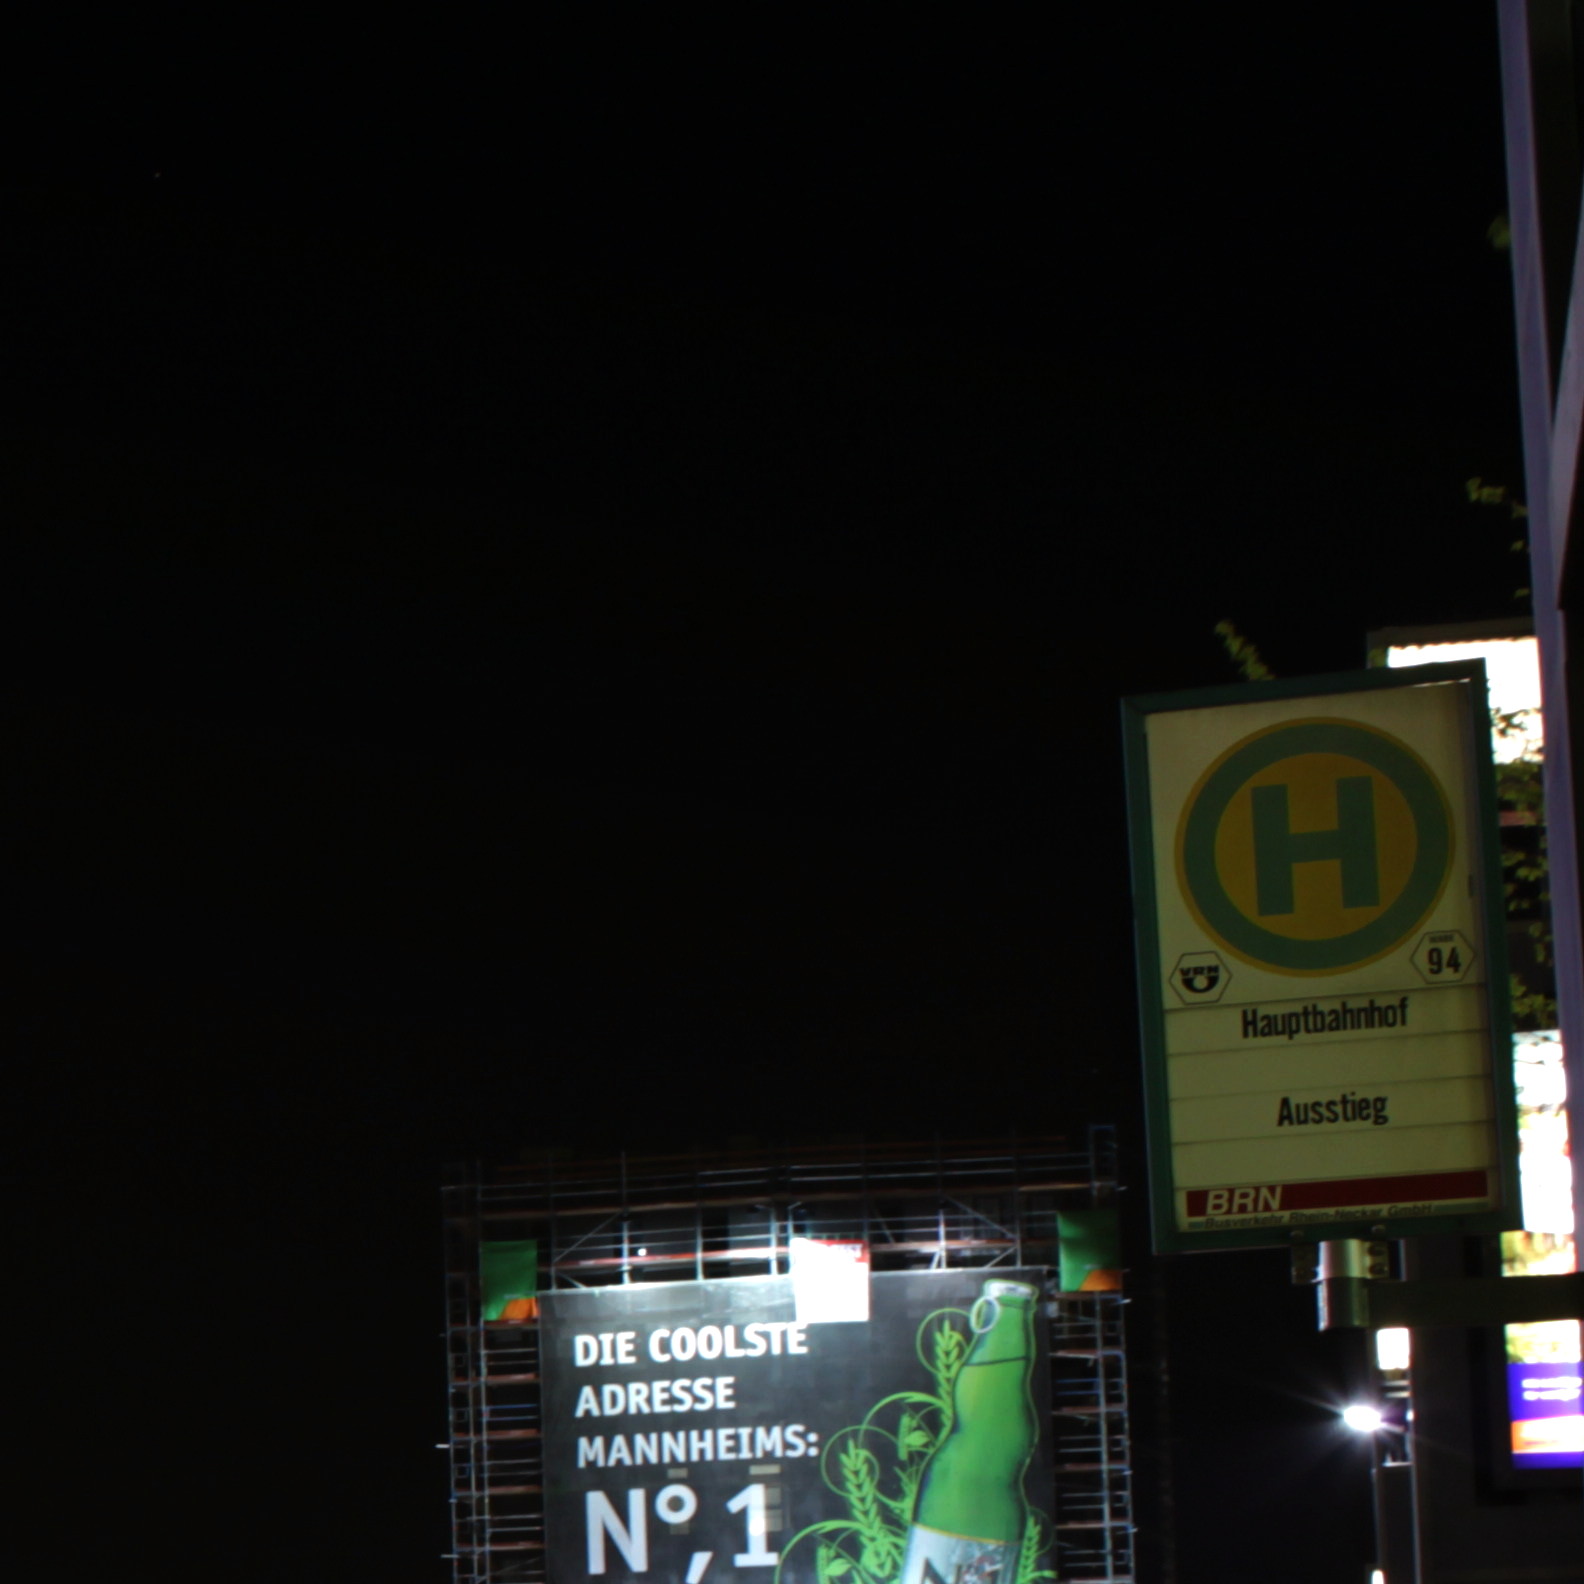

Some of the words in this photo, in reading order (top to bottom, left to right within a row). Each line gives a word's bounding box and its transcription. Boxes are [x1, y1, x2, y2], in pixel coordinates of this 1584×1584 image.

[1250, 775, 1381, 917] H
[1426, 946, 1463, 976] 94
[1241, 997, 1410, 1042] Hauptbahnhof
[1277, 1091, 1389, 1128] Ausstieg
[1205, 1185, 1282, 1217] BRN
[1289, 1206, 1383, 1225] Rhein-Neckar
[1388, 1203, 1433, 1218] GmbH
[574, 1331, 637, 1367] DIE
[648, 1321, 809, 1361] COOLSTE
[575, 1376, 736, 1418] ADRESSE
[577, 1423, 820, 1468] MANNHEIMS:
